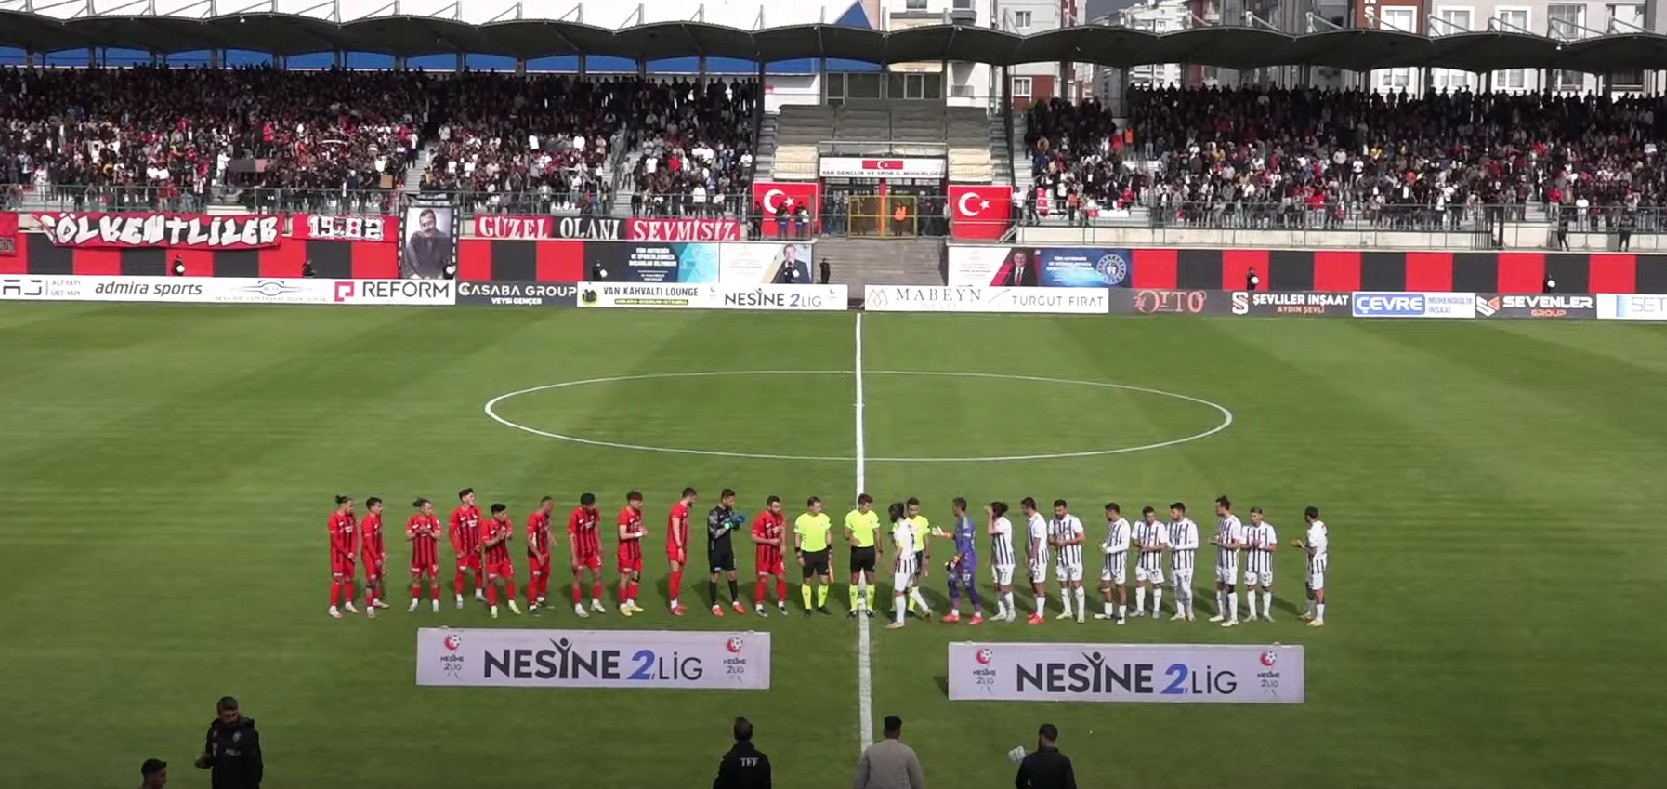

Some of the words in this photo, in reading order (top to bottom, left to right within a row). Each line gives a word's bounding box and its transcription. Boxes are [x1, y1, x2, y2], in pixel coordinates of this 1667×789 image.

[95, 281, 149, 295] admira
[153, 283, 203, 296] sports
[362, 281, 449, 298] REFORM
[458, 282, 520, 296] CASABA
[525, 285, 577, 297] GROUP
[604, 287, 620, 295] VAN
[622, 287, 663, 296] KAHVALTI
[666, 287, 698, 297] LOUNGE
[896, 288, 981, 301] MABEYN
[1069, 296, 1104, 307] FIRAT
[1356, 296, 1423, 313] ÇEVRE
[1502, 296, 1594, 308] SEVENLER
[1531, 309, 1567, 317] GROUP
[740, 757, 758, 767] TFF
